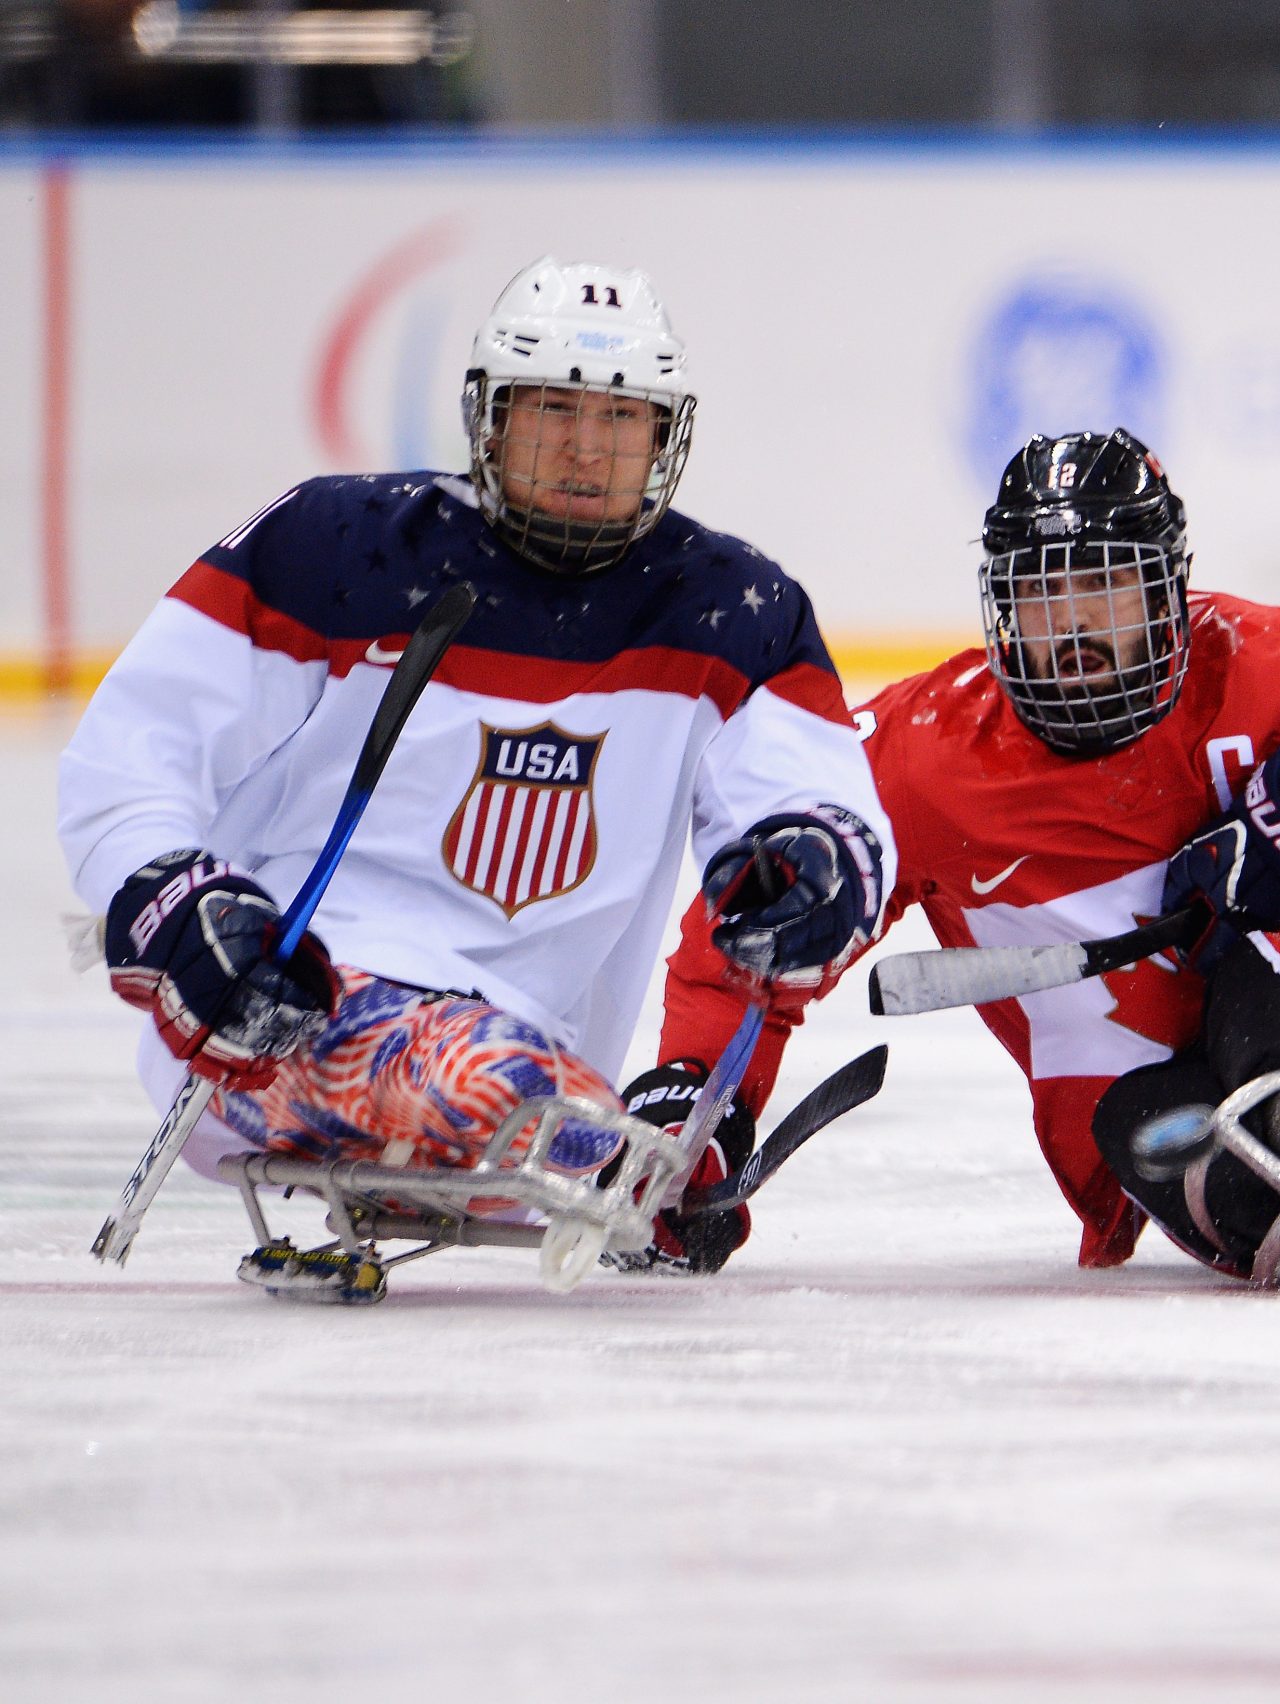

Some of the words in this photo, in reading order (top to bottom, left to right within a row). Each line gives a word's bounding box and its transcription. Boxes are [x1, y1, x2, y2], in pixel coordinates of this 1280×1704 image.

[581, 284, 622, 309] 11
[1048, 462, 1078, 488] 12
[496, 739, 579, 780] USA
[1206, 735, 1255, 812] C
